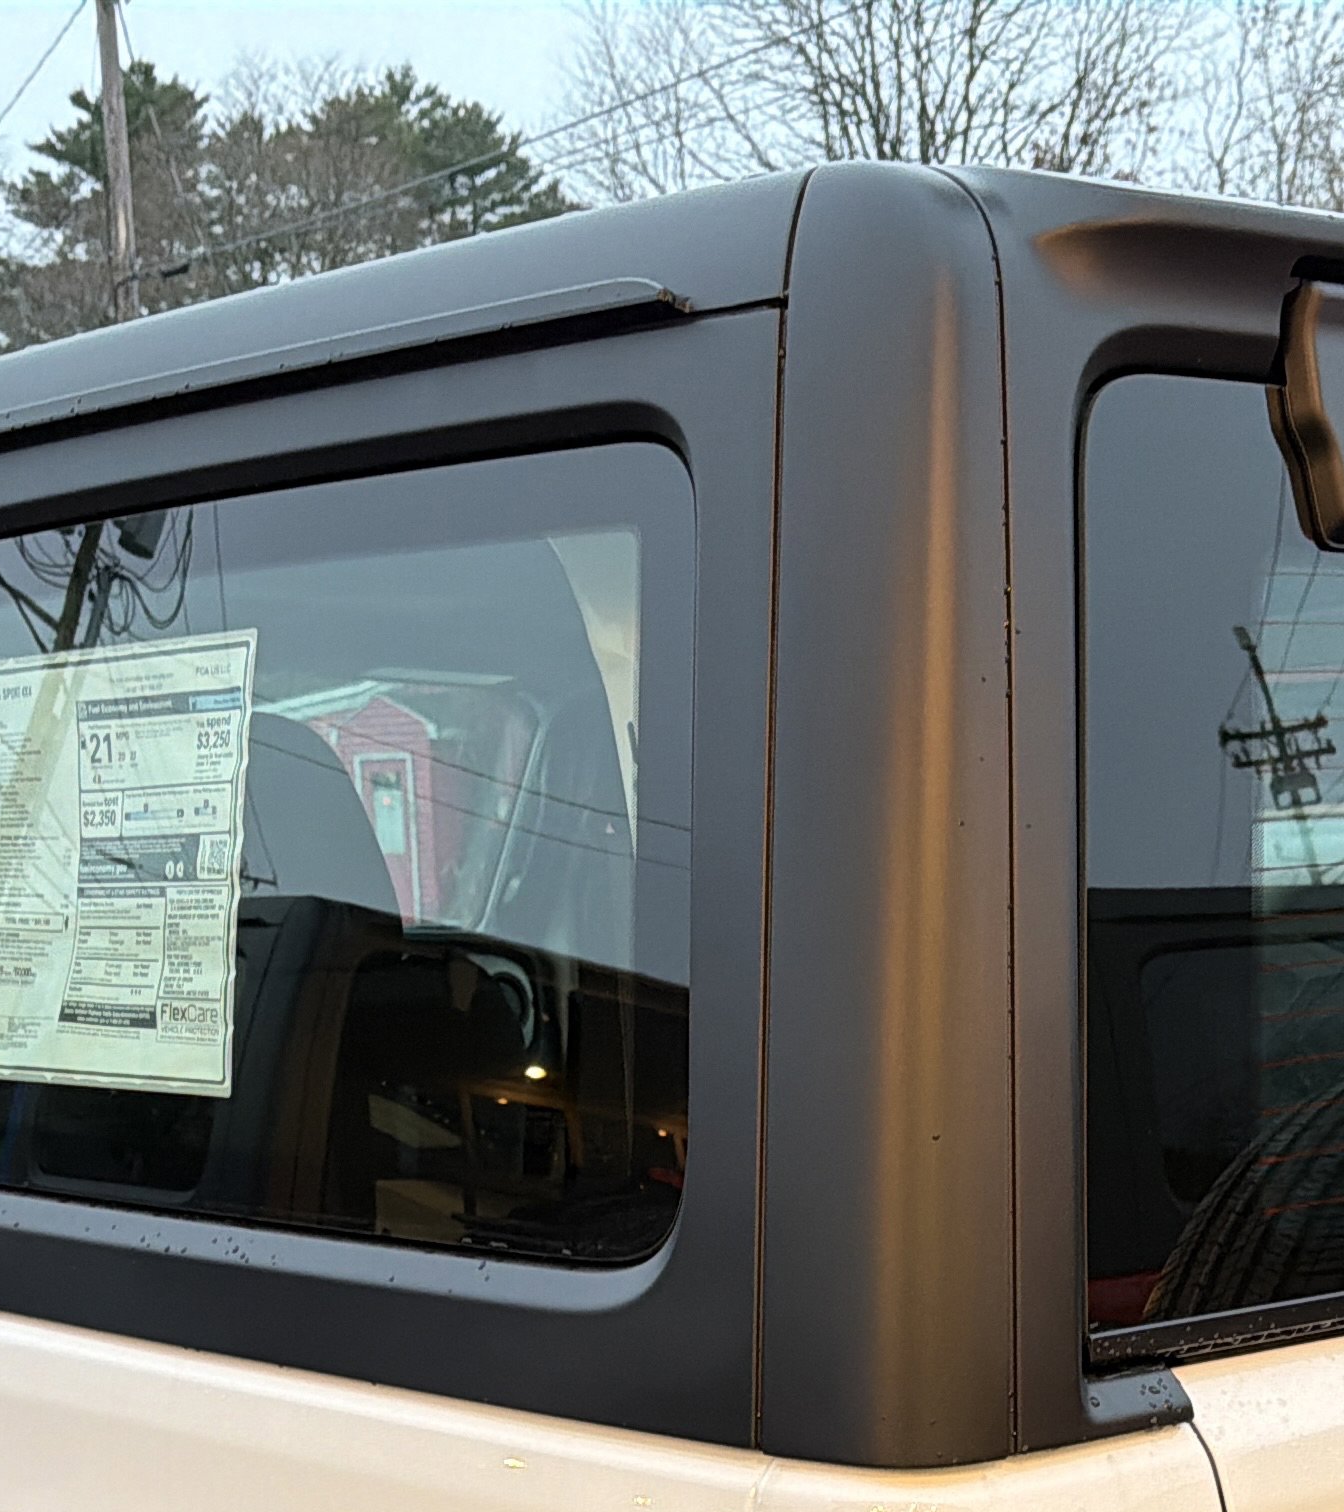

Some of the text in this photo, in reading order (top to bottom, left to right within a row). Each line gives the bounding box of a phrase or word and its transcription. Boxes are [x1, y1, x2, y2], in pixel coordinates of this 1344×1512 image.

[206, 715, 231, 730] spend
[89, 733, 113, 764] 21
[196, 730, 231, 751] $3,250
[83, 809, 116, 830] $2,350
[160, 1002, 218, 1024] FlexCare
